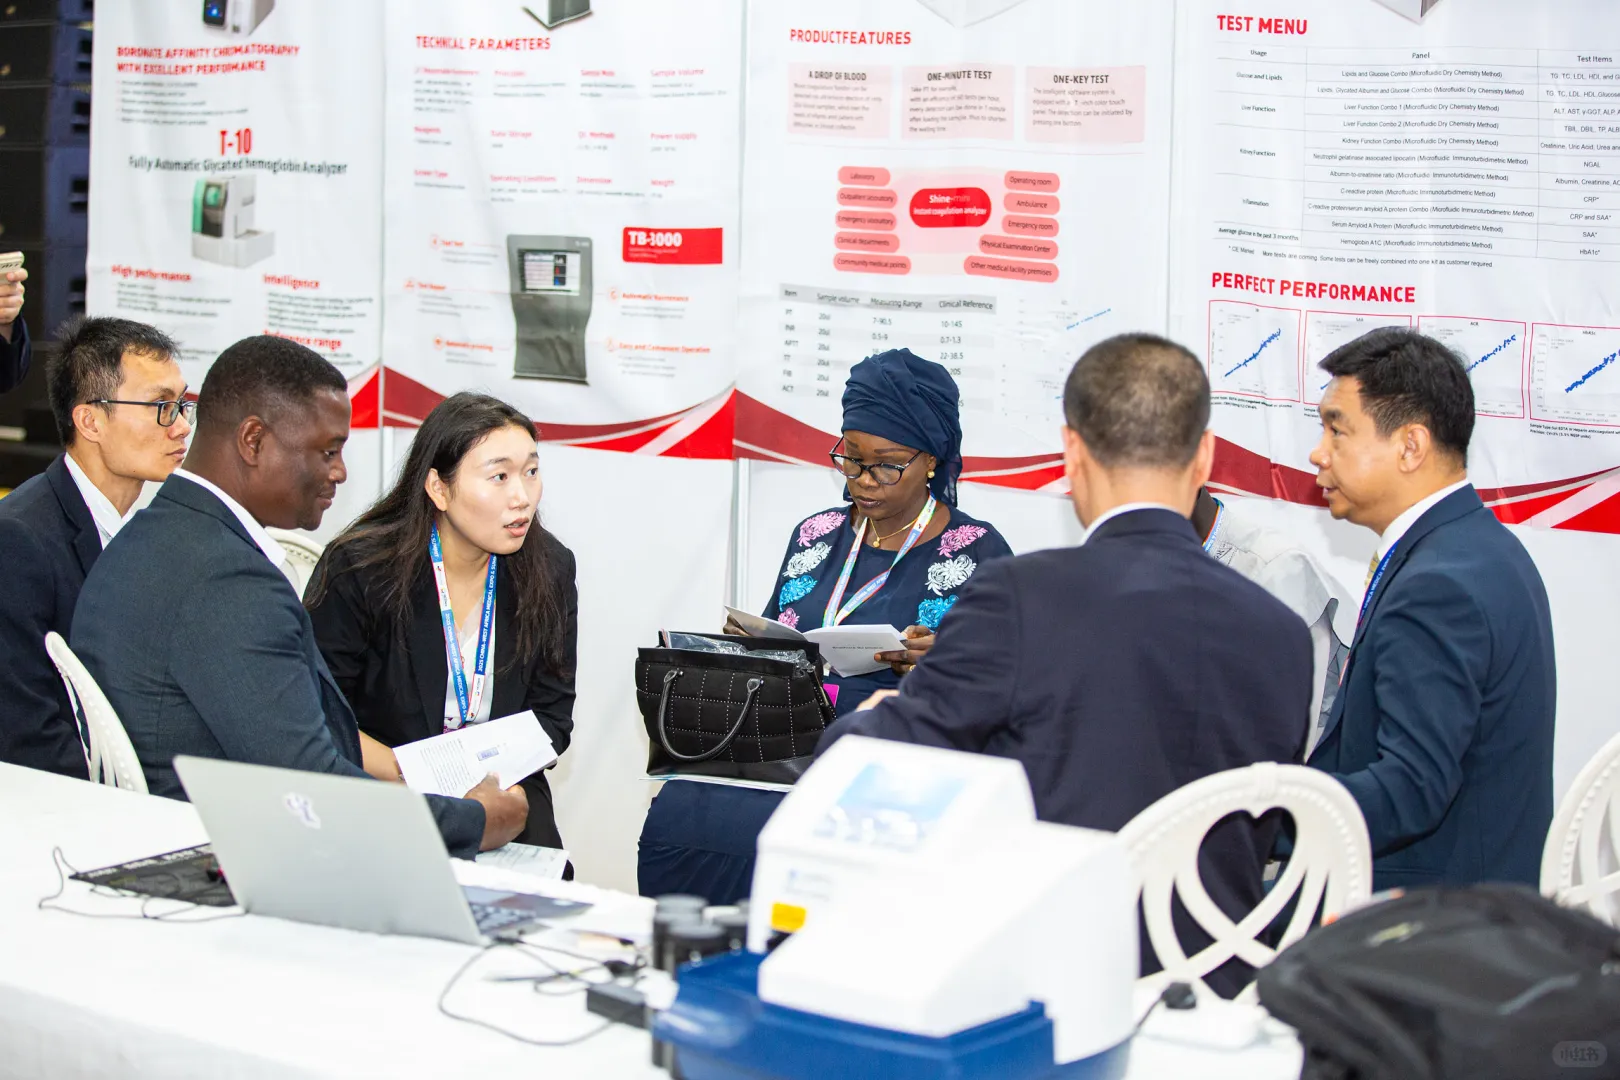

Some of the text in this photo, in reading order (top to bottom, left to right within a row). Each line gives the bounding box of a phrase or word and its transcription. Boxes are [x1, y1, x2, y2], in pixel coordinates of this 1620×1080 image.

[1217, 15, 1308, 35] TEST MENU
[416, 36, 551, 50] TECHNICAL PARAMETERS
[165, 47, 210, 59] AFFINITY
[1250, 49, 1268, 58] Usage
[117, 62, 142, 74] WITH
[196, 60, 266, 75] PERFORMANCE
[808, 70, 866, 80] A DROP OF BLOOD
[927, 70, 992, 81] ONE-MINUTE TEST
[1053, 74, 1110, 84] ONE-KEY TEST
[1342, 70, 1357, 78] Lipids
[1442, 70, 1452, 78] Dry
[1454, 70, 1480, 78] Chemistry
[1467, 87, 1477, 95] Dry
[1478, 88, 1504, 96] Chemistry
[1438, 120, 1448, 128] Dry
[220, 128, 252, 156] T-10
[1342, 138, 1359, 146] Kidney
[1438, 138, 1448, 146] Dry
[1448, 138, 1476, 146] Chemistry
[1452, 156, 1506, 164] Immunoturbidimetric
[129, 156, 152, 172] Fully
[154, 158, 200, 172] Automatic
[302, 160, 348, 178] Analyzer
[1486, 174, 1509, 182] Method)
[1384, 188, 1418, 196] (Microfluidic
[1420, 189, 1474, 197] Immunoturbidimetric
[1016, 200, 1048, 208] Ambulance
[1008, 220, 1054, 230] Emergency room
[628, 230, 682, 248] TB-3000
[1416, 240, 1471, 248] Immunoturbidimetric
[981, 240, 1001, 249] Physical
[1002, 242, 1033, 251] Examination
[970, 262, 1052, 277] Other medical facility premises
[262, 274, 320, 290] Intelligence
[1212, 272, 1416, 303] PERFECT PERFORMANCE
[902, 300, 923, 308] Range
[939, 300, 962, 308] Clinical
[962, 300, 994, 310] Reference
[940, 336, 962, 344] 0.7-1.3
[940, 352, 964, 360] 22-38.5
[480, 628, 488, 660] CHINA-WEST
[486, 589, 494, 610] MEDICAL
[446, 626, 458, 658] CHINA-WEST
[452, 656, 460, 676] AFRICA
[455, 675, 464, 696] MEDICAL
